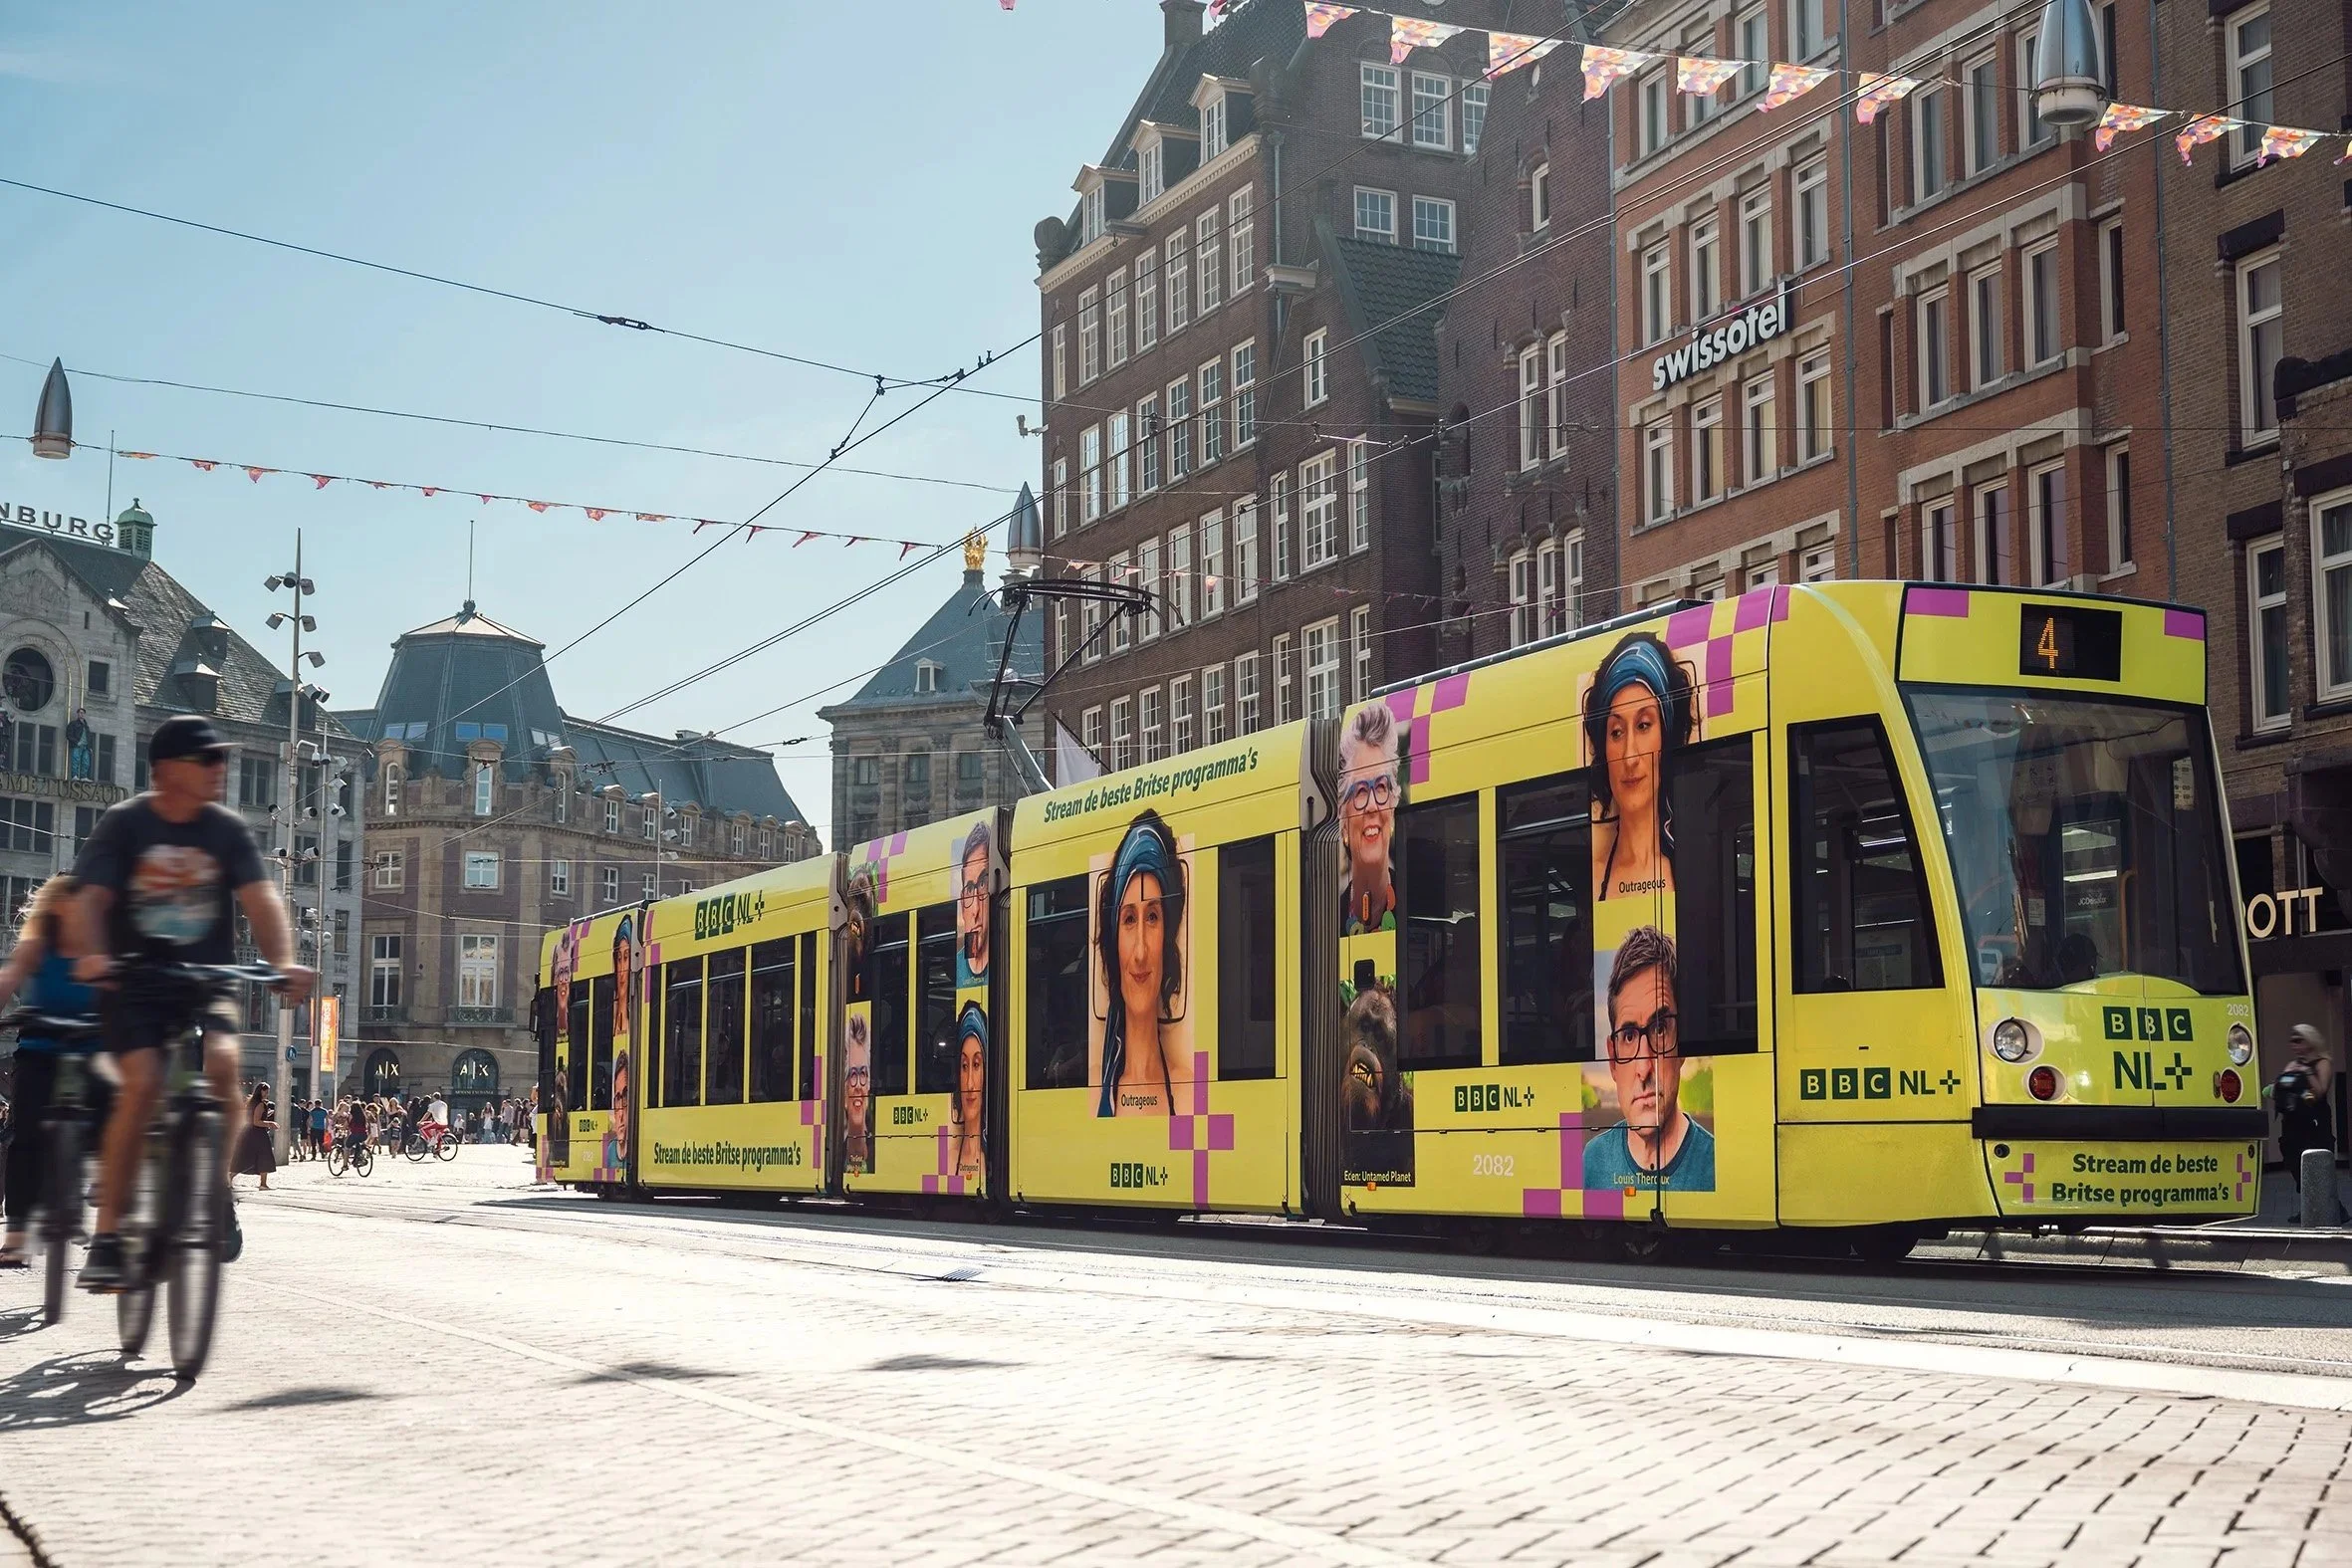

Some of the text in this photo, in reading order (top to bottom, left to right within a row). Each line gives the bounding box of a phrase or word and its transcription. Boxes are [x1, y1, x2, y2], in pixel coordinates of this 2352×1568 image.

[2037, 617, 2058, 669] 4
[1045, 747, 1258, 822] Stream de beste Britse programma's
[1618, 878, 1666, 893] Outrageous
[696, 897, 734, 937] BBC
[2242, 887, 2323, 938] OTT
[2227, 1004, 2249, 1016] 2082
[2107, 1009, 2190, 1038] BBC
[1804, 1070, 1887, 1096] BBC
[1121, 1093, 1158, 1109] Outrageous
[1456, 1087, 1499, 1109] BBC
[654, 1141, 801, 1172] Stream de beste Britse programma's
[1473, 1154, 1515, 1177] 2082
[2073, 1153, 2218, 1174] Stream de beste
[1112, 1166, 1142, 1185] BBC
[1362, 1170, 1389, 1182] Untamed
[1391, 1171, 1411, 1183] Planet
[1613, 1173, 1634, 1185] Louis
[2052, 1182, 2230, 1207] Britse programma's
